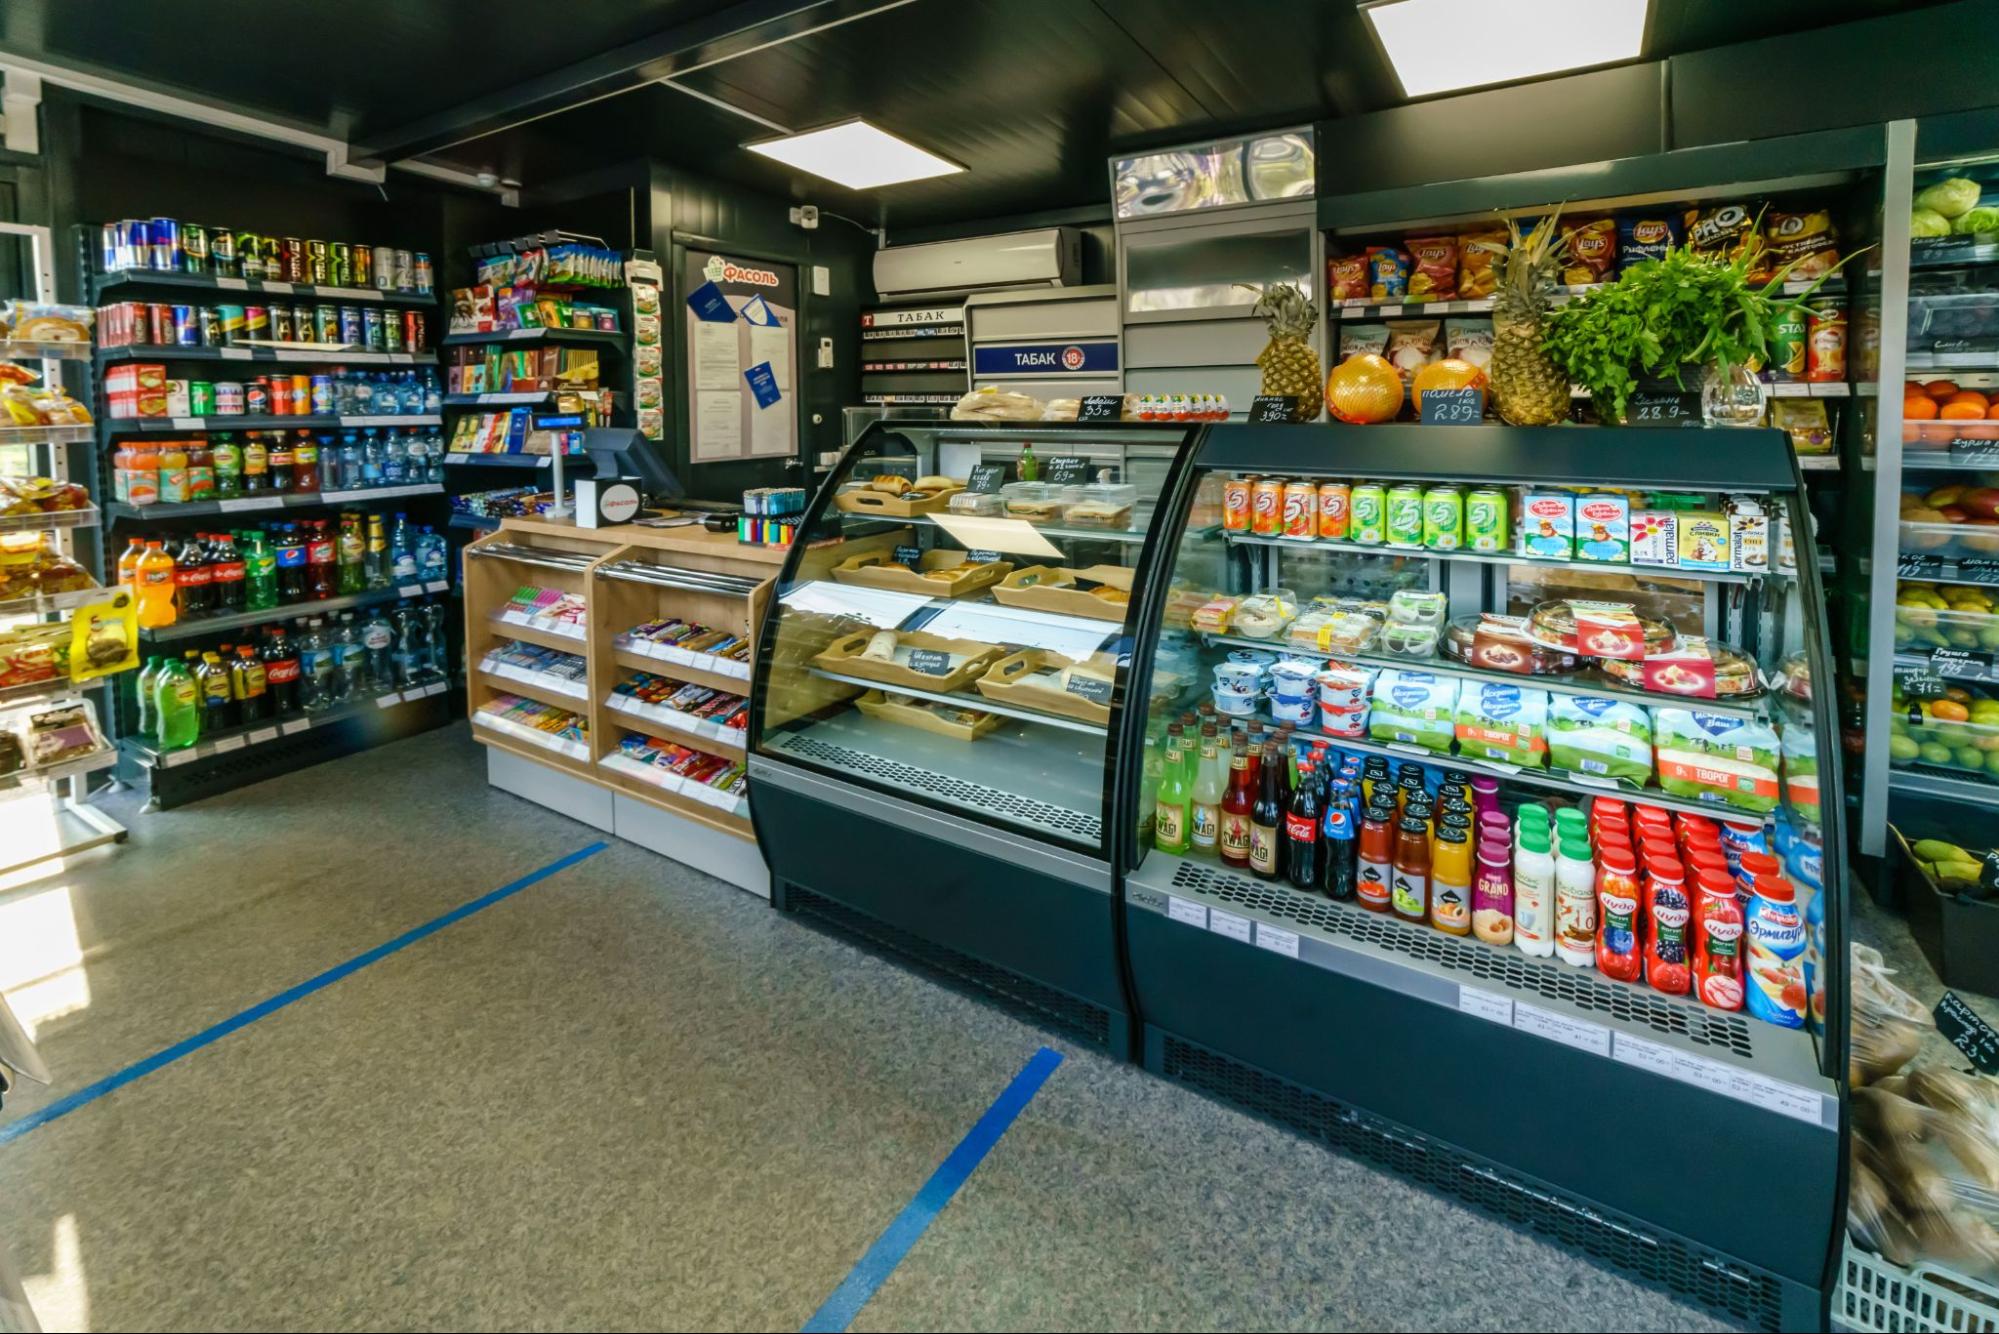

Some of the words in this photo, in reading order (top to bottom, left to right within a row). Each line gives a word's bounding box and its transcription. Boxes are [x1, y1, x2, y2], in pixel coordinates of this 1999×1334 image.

[1693, 206, 1746, 240] PRO
[314, 242, 325, 280] DRIVE
[723, 264, 778, 286] ФАСОЛЬ
[897, 310, 945, 323] ТАБАК
[1014, 353, 1056, 366] ТАБАК
[1664, 518, 1675, 564] parmalat
[1732, 531, 1743, 569] parmalat
[1695, 767, 1731, 784] ТВОРОГ
[1478, 879, 1509, 897] GRAND
[1750, 920, 1806, 944] Эрмигур
